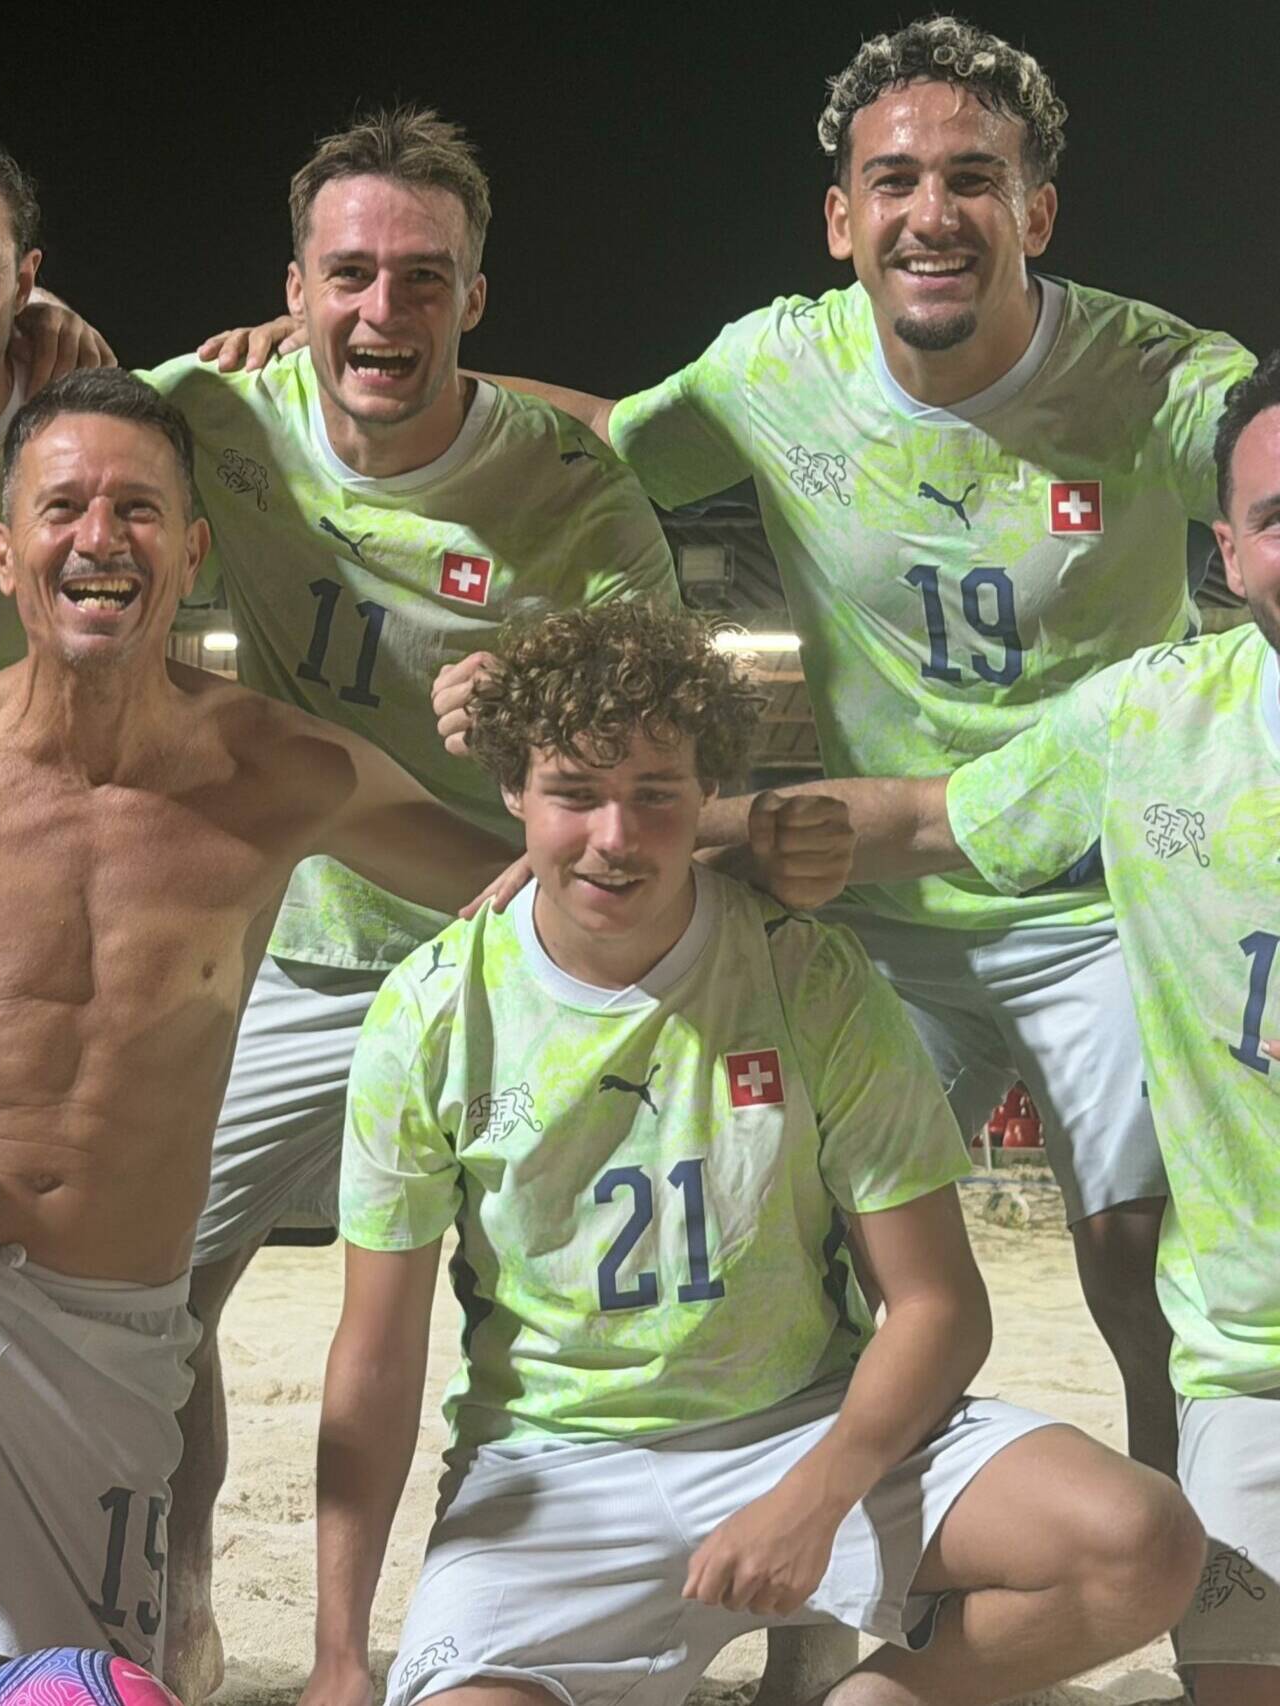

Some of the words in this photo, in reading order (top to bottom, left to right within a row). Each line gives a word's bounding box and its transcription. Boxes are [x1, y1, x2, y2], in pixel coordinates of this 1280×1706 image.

[296, 578, 389, 708] 11
[904, 564, 1023, 687] 19
[594, 1158, 725, 1311] 21
[89, 1486, 166, 1635] 15
